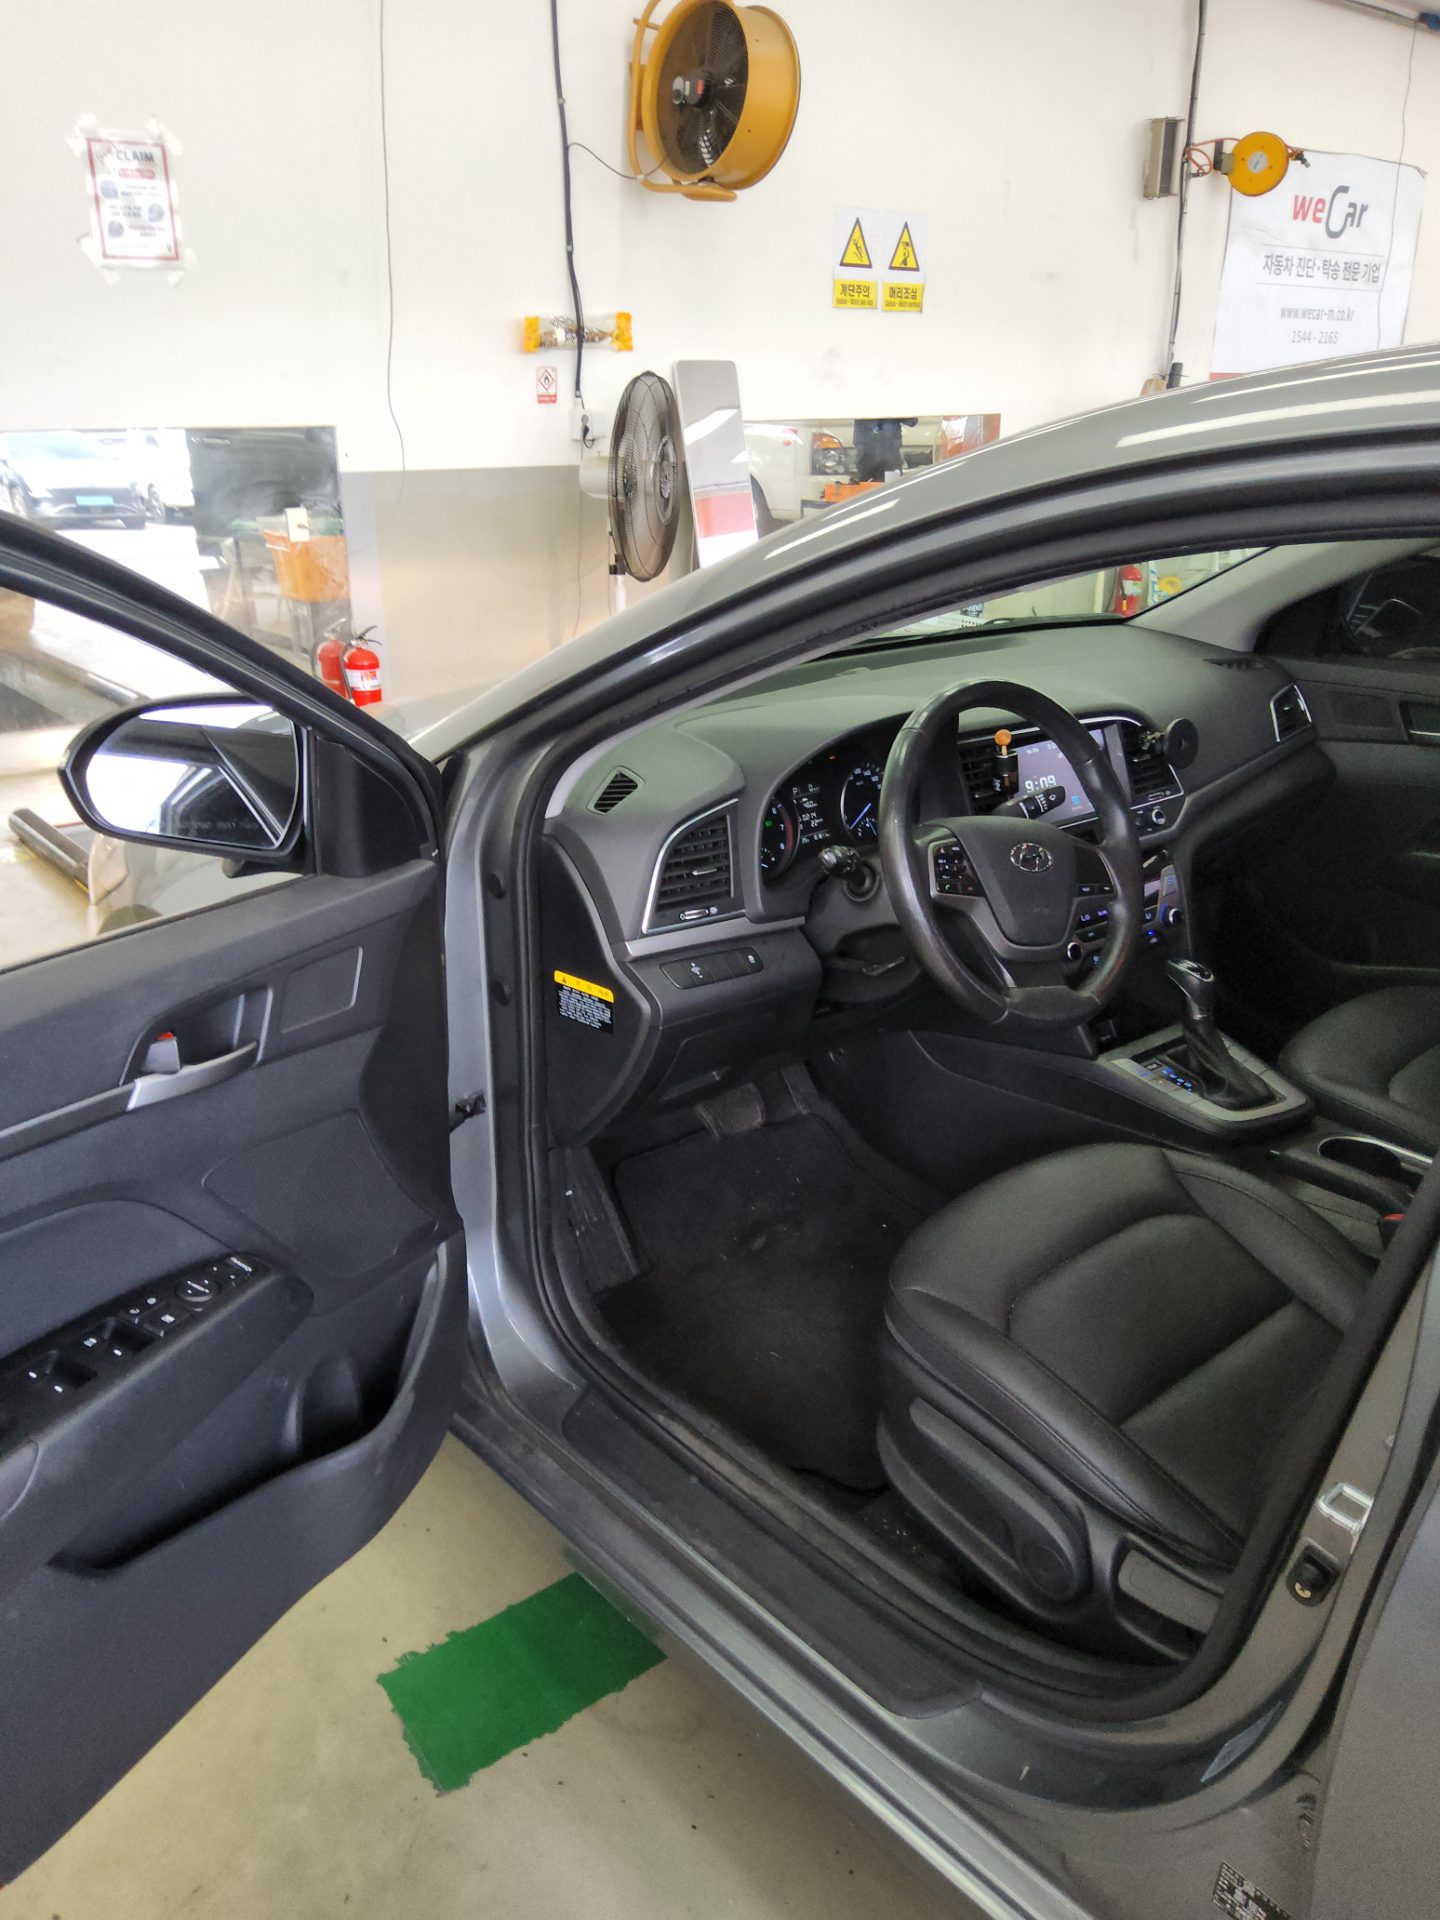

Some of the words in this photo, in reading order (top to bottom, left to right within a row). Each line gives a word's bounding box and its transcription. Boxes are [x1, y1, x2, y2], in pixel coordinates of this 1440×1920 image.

[116, 150, 154, 163] CLAIM
[1292, 185, 1369, 239] weCar
[1262, 252, 1294, 277] 자동차
[1342, 261, 1361, 282] 전문
[1362, 262, 1381, 283] 기업
[840, 283, 870, 297] 계단주의
[889, 287, 918, 300] 머리조심
[1280, 306, 1355, 322] www.wecar-m.co.kr
